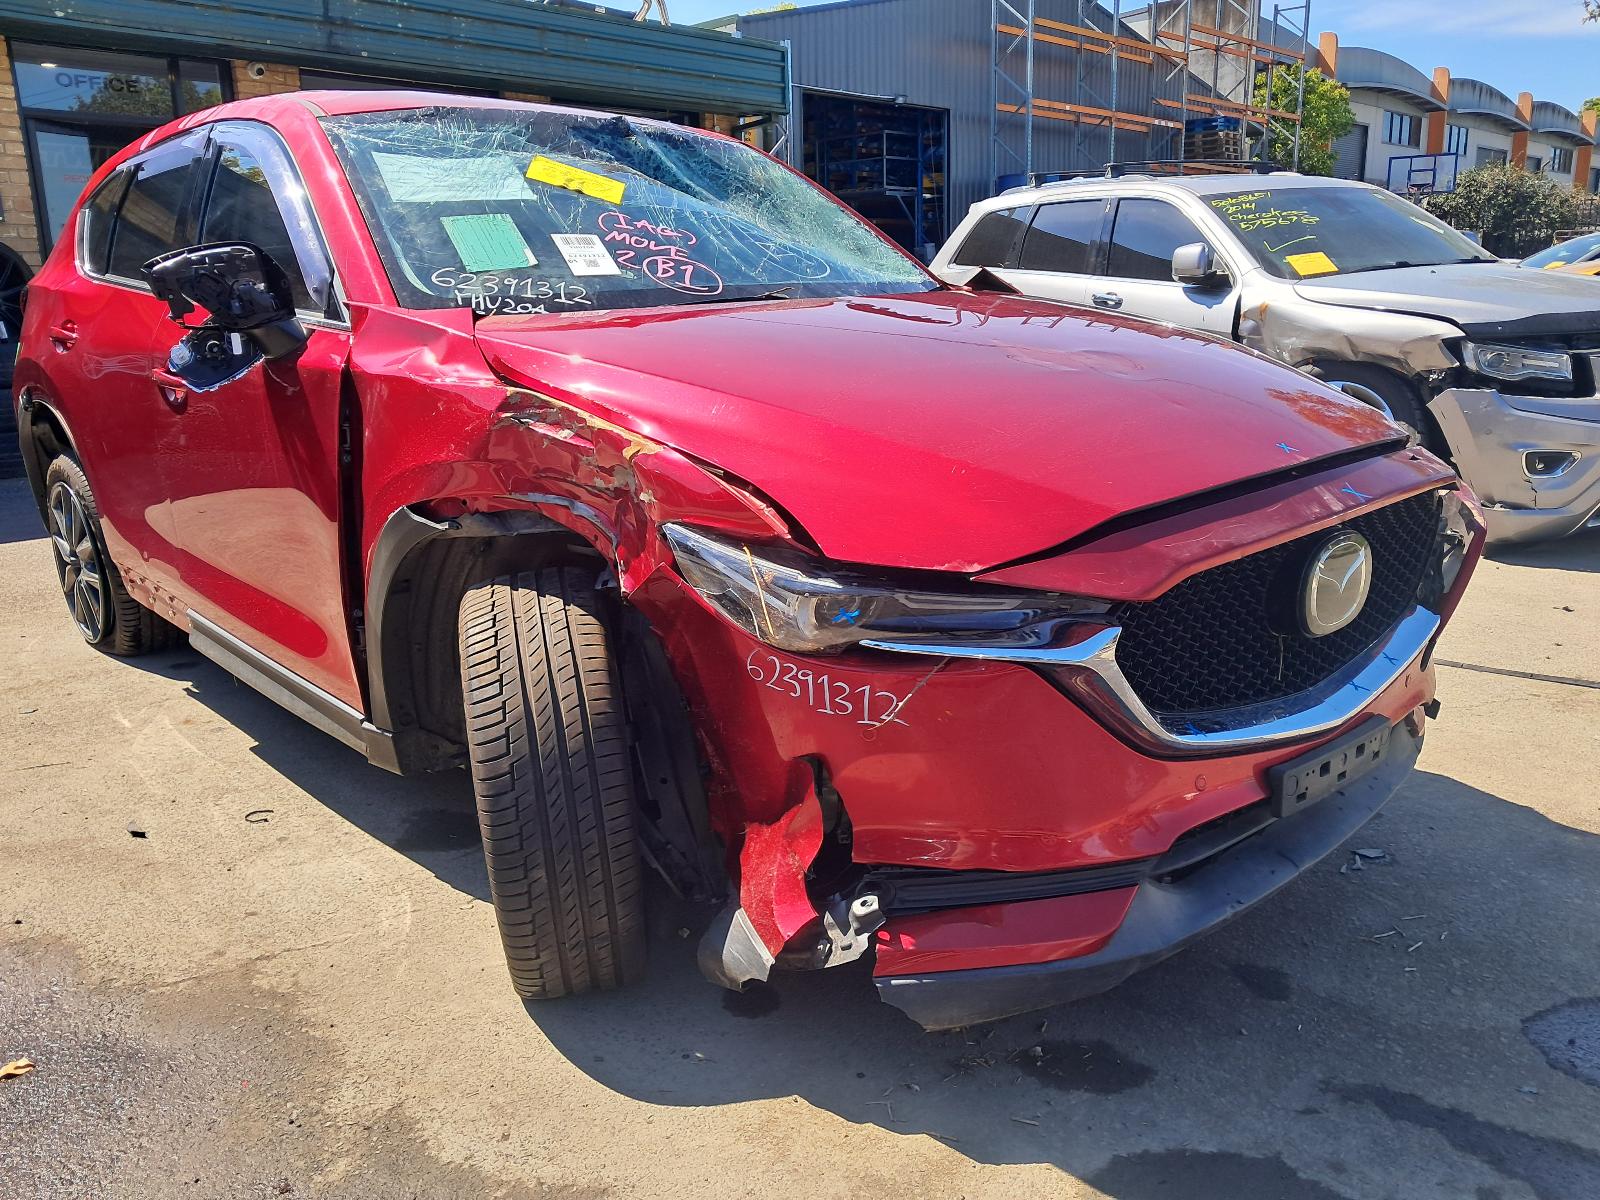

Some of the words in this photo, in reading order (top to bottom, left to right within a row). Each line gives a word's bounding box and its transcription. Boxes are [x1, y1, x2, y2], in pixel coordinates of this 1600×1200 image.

[55, 72, 142, 93] OFFICE
[1222, 202, 1256, 214] 2014
[431, 268, 592, 305] 62391312
[747, 648, 910, 727] 62391312
